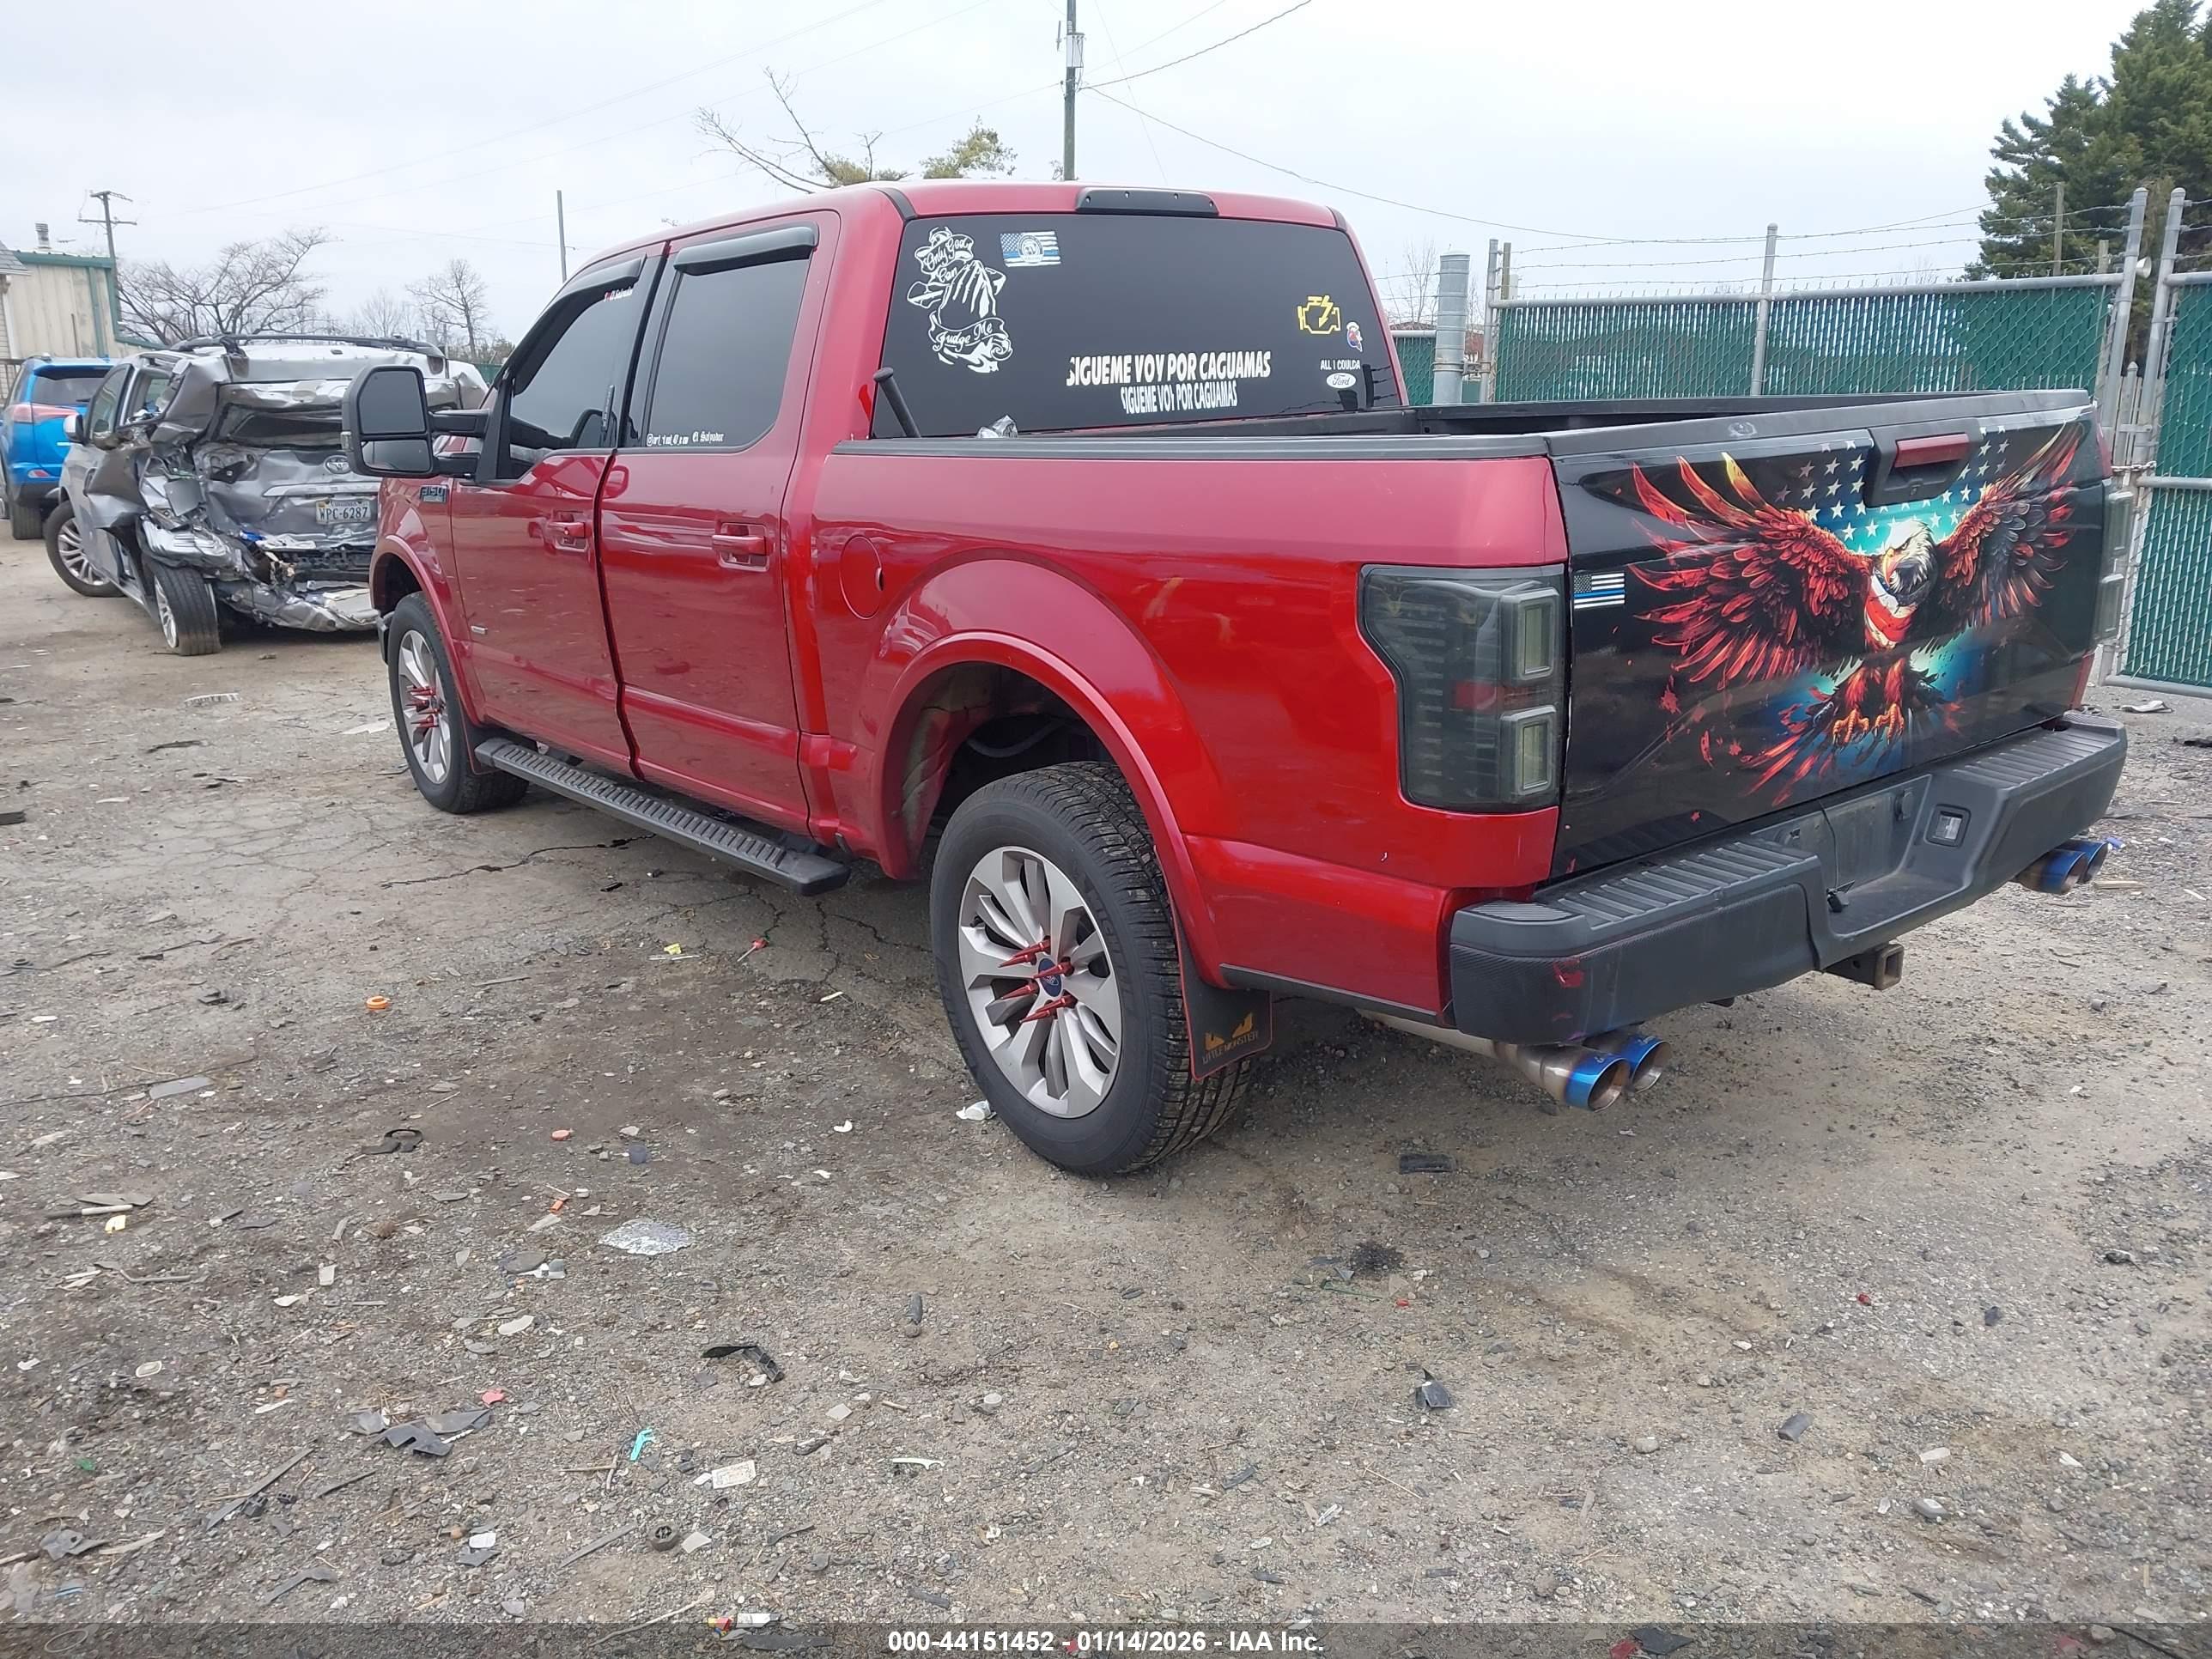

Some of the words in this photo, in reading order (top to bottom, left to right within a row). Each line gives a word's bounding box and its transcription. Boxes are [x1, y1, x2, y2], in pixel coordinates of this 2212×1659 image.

[925, 245, 947, 270] Only
[945, 236, 969, 257] God
[937, 265, 958, 283] Can
[932, 331, 971, 353] Judge
[974, 321, 994, 340] Me
[1134, 353, 1165, 383] VOY
[1167, 352, 1197, 381] POR
[1199, 350, 1272, 380] CAGUAMAS
[1320, 360, 1332, 371] ALL
[1333, 360, 1336, 370] I
[1332, 374, 1351, 386] Ford
[1176, 383, 1194, 411] POR
[1194, 380, 1238, 409] CAGUAMAS
[319, 507, 368, 520] WPC-6287
